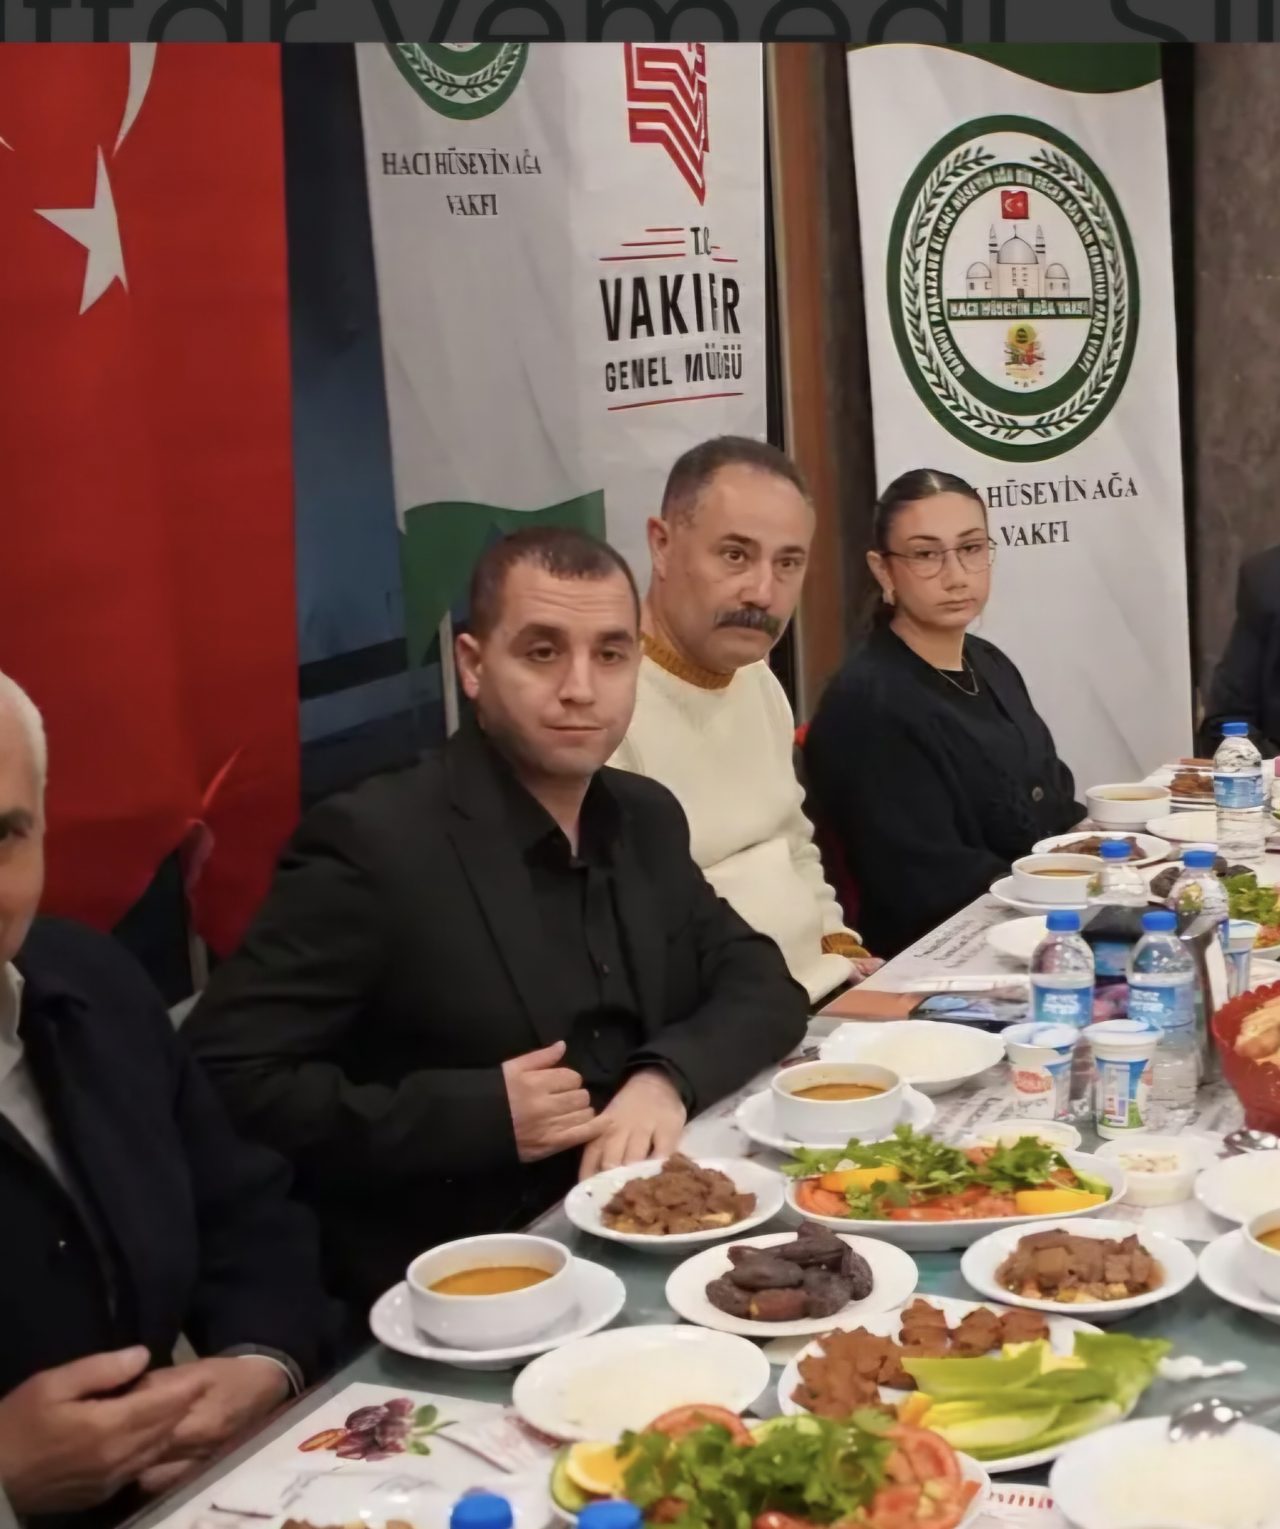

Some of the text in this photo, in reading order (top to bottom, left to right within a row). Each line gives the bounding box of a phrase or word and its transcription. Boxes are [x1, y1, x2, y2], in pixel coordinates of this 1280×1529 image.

[382, 152, 431, 175] HACI
[446, 193, 498, 216] VAKFI
[605, 356, 673, 393] GENEL
[986, 471, 1139, 508] HÜSEYİN AĞA
[1000, 520, 1070, 547] VAKFI
